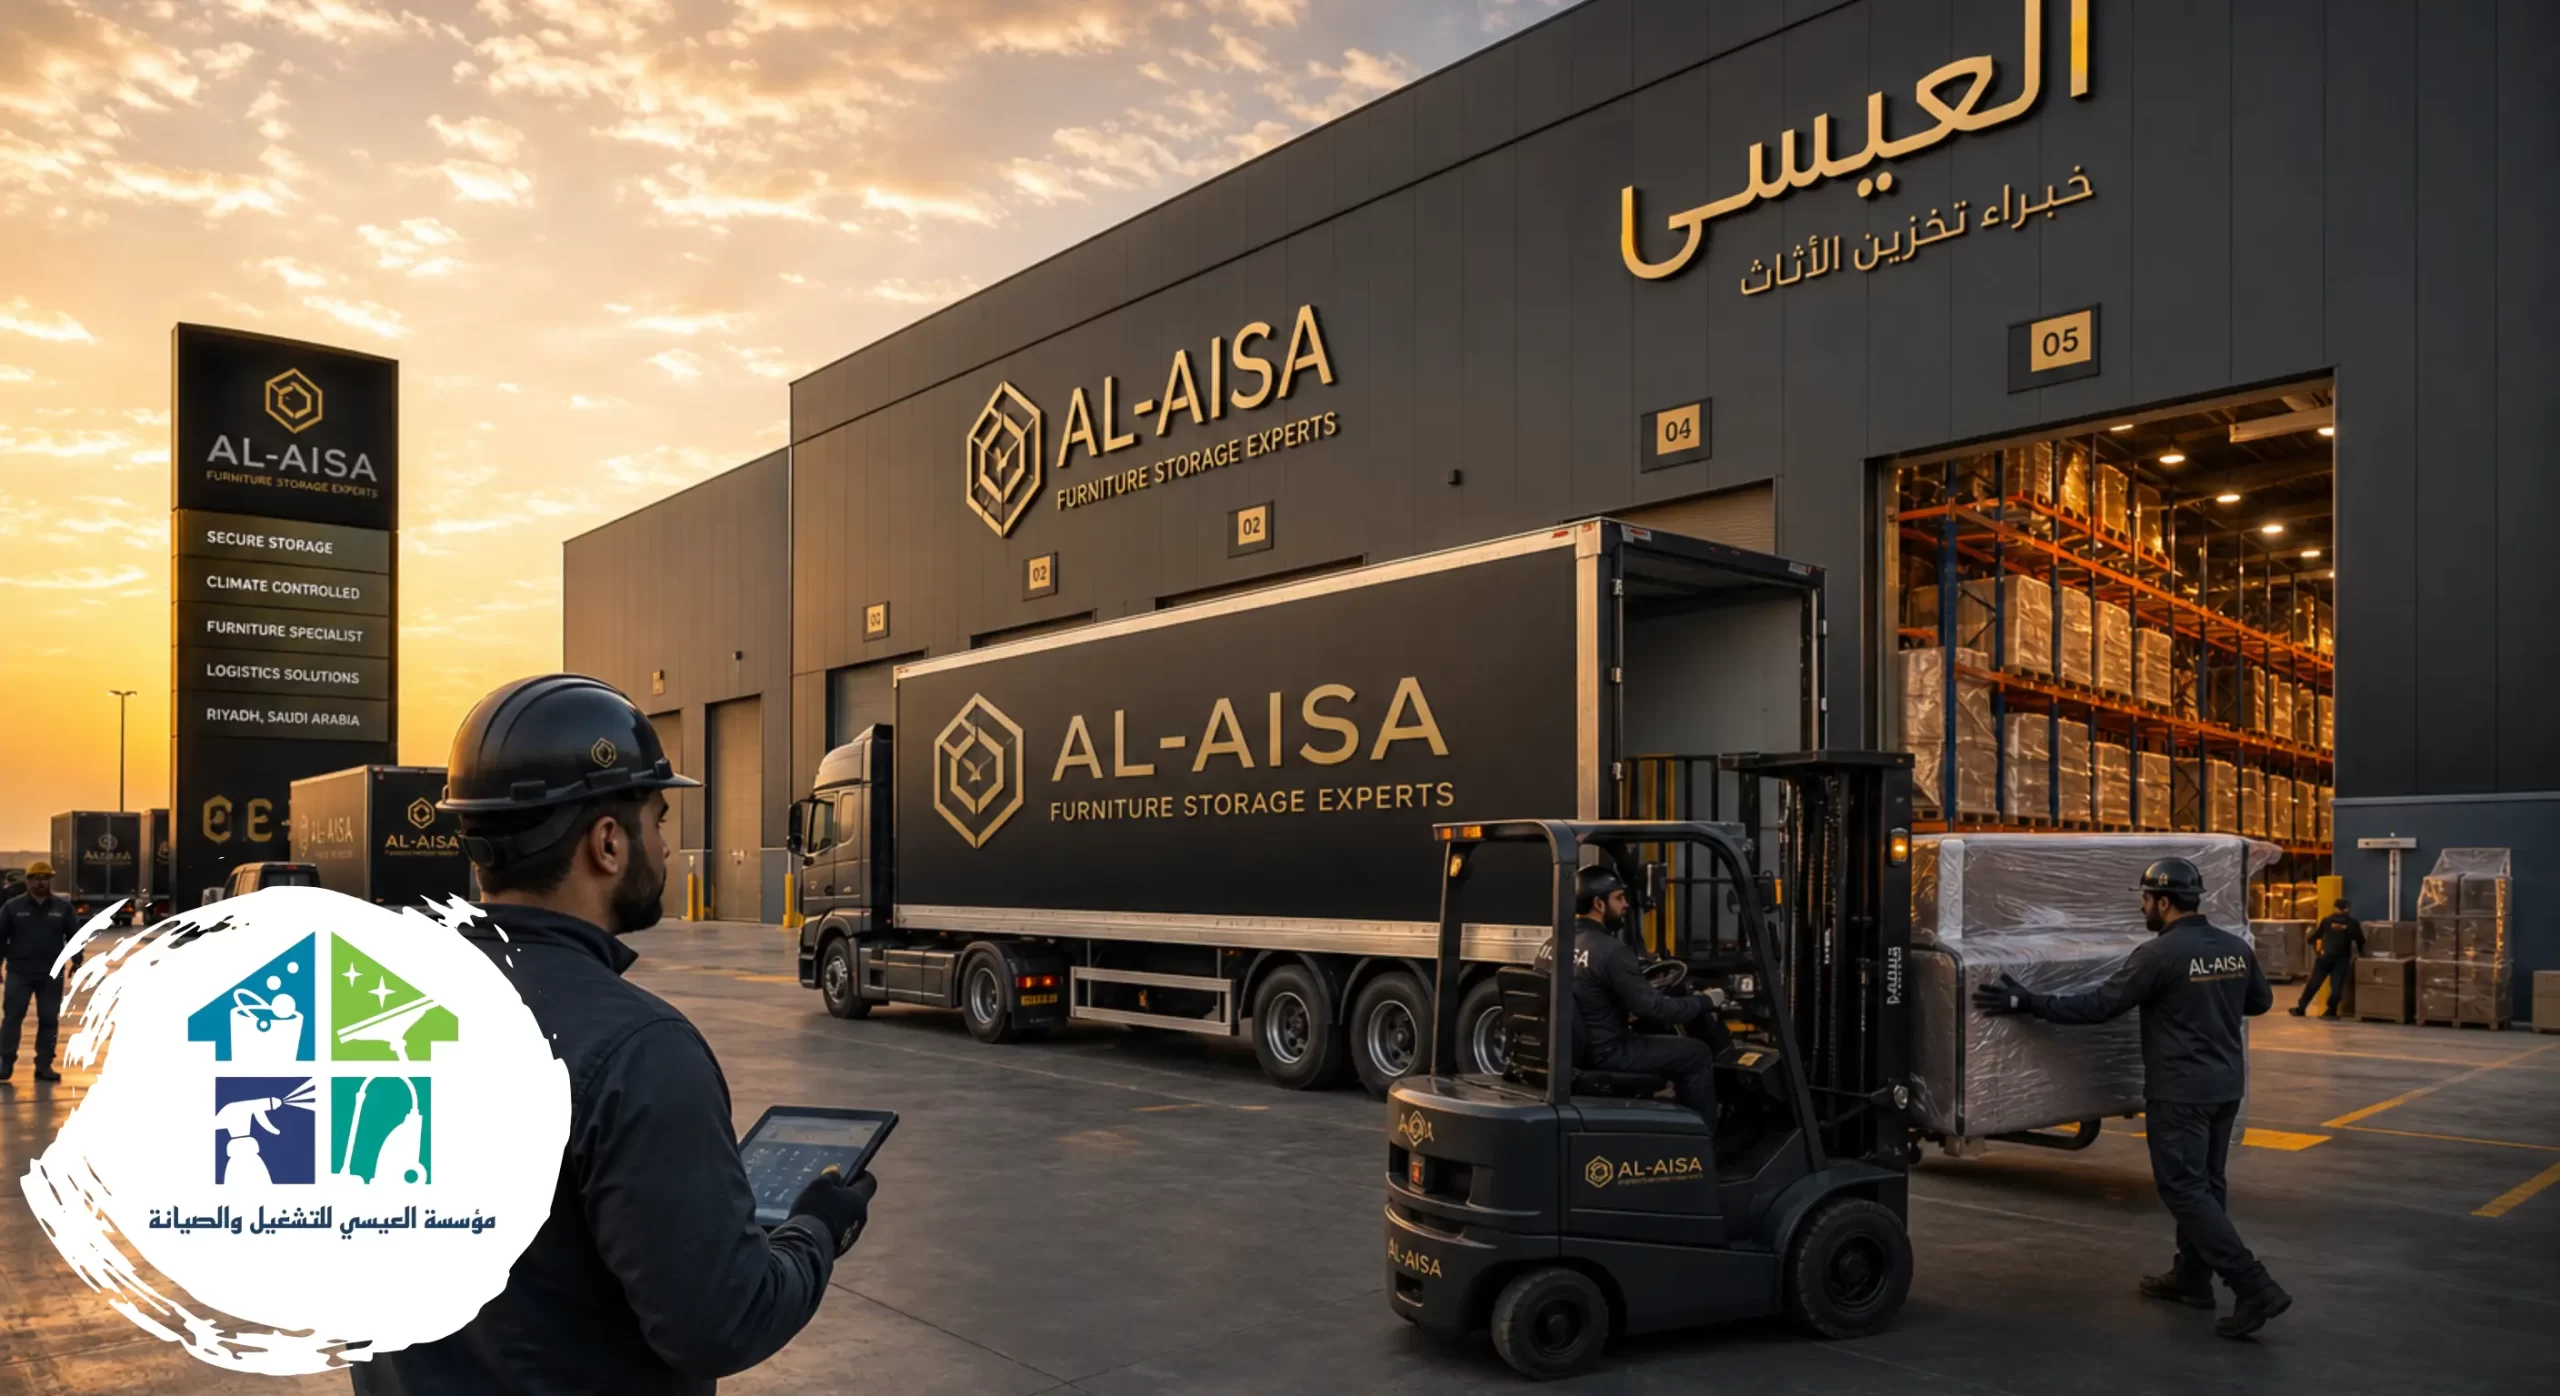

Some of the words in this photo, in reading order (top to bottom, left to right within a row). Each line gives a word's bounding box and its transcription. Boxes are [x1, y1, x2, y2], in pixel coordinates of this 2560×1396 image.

[1980, 165, 2093, 229] خبراء
[1854, 200, 1967, 271] تخزين
[1740, 234, 1840, 295] الأثاث
[2042, 325, 2080, 358] 05
[1056, 304, 1334, 468] AL-AISA
[1664, 416, 1692, 443] 04
[206, 434, 378, 483] AL-AISA
[1057, 465, 1149, 511] FURNITURE
[1154, 439, 1241, 485] STORAGE
[1246, 411, 1337, 458] EXPERTS
[206, 470, 273, 487] FURNITURE
[276, 478, 329, 494] STORAGE
[1243, 516, 1262, 536] 02
[207, 530, 265, 548] SECURE
[268, 537, 333, 554] STORAGE
[1032, 565, 1047, 582] 02
[206, 575, 268, 592] CLIMATE
[272, 581, 360, 600] CONTROLLED
[207, 620, 286, 637] FURNITURE
[289, 626, 364, 642] SPECIALIST
[207, 664, 281, 680] LOGISTICS
[284, 669, 360, 684] SOLUTIONS
[206, 708, 264, 724] RIYADH,
[267, 711, 308, 724] SAUDI
[311, 713, 360, 727] ARABIA
[1051, 676, 1450, 783] AL-AISA
[1050, 796, 1174, 822] FURNITURE
[1184, 790, 1305, 817] STORAGE
[1319, 781, 1455, 812] EXPERTS
[385, 833, 460, 849] AL-AISA
[2189, 956, 2248, 976] AL-AISA
[1617, 1156, 1703, 1178] AL-AISA
[1387, 1237, 1443, 1278] AL-AISA
